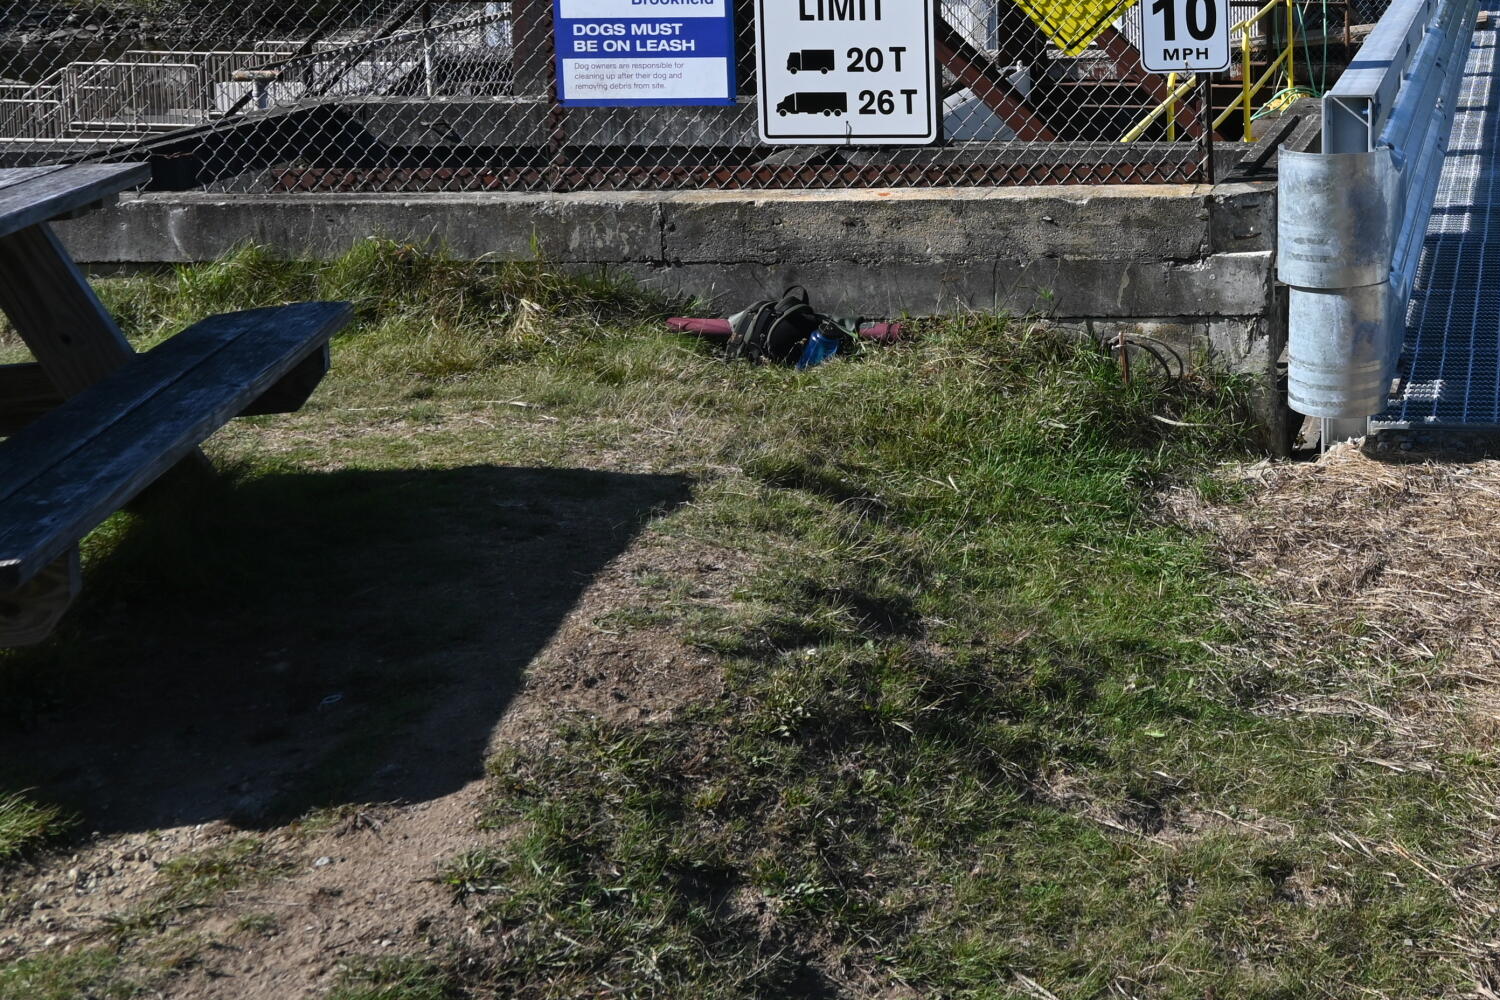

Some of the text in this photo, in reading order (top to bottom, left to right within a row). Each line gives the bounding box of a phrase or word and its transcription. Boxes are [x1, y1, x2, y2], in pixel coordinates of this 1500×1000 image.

[573, 23, 683, 36] DOGS MUST
[573, 39, 695, 52] BE ON LEASH
[846, 47, 906, 73] 20 T
[1163, 48, 1209, 61] MPH
[574, 62, 589, 70] Dog
[632, 62, 672, 70] responsible
[574, 72, 605, 81] cleaning
[652, 72, 667, 80] dog
[609, 82, 632, 90] debris
[858, 89, 918, 116] 26 T
